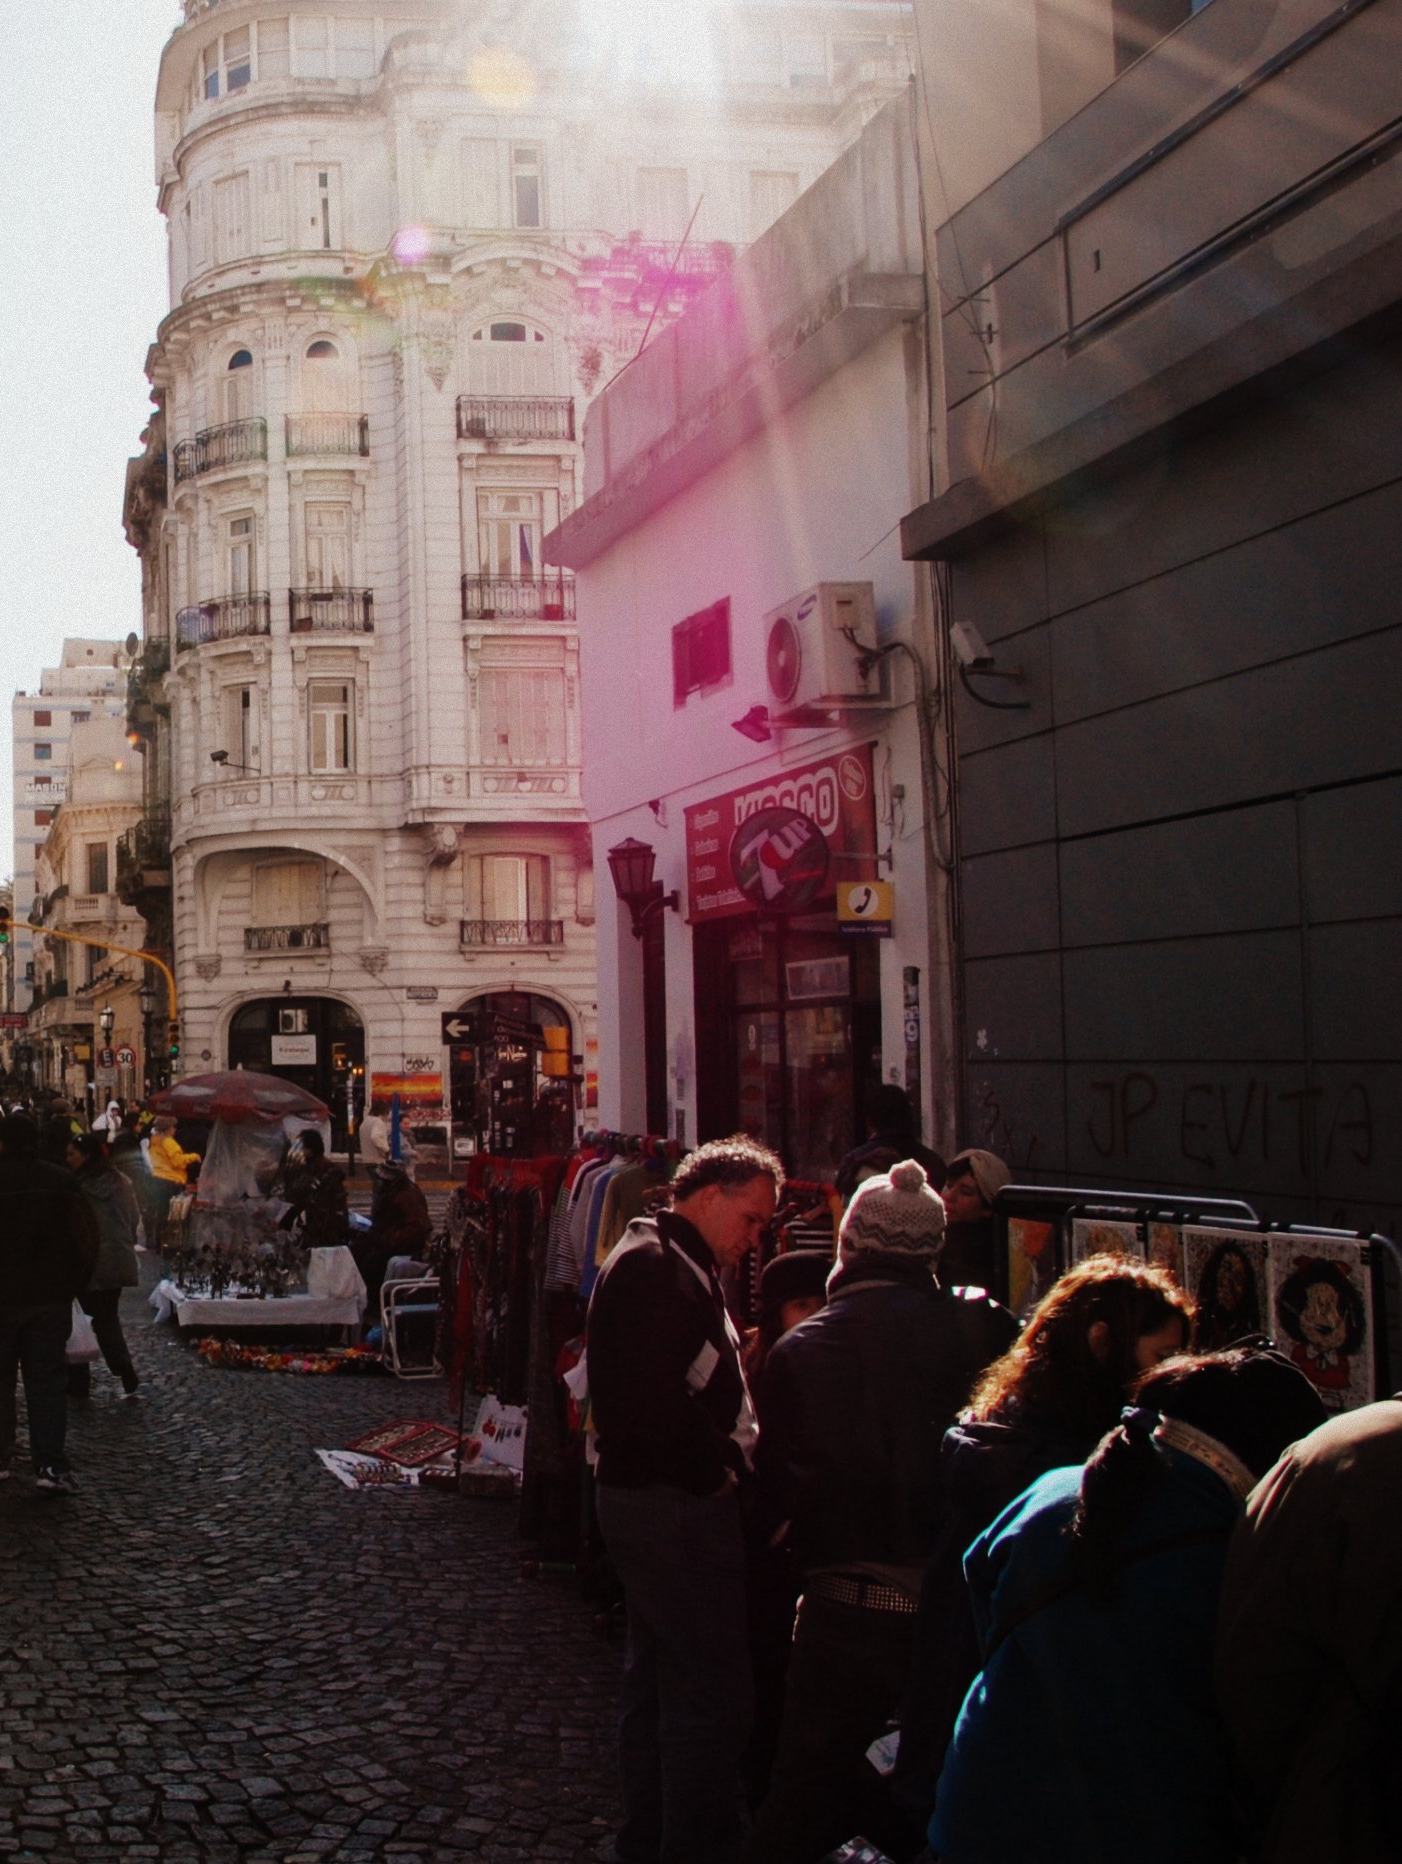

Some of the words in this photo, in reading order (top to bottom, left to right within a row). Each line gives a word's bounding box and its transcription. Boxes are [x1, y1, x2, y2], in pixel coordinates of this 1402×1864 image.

[117, 1052, 133, 1064] 30
[1086, 1072, 1158, 1158] JP
[1180, 1077, 1374, 1177] EVITA
